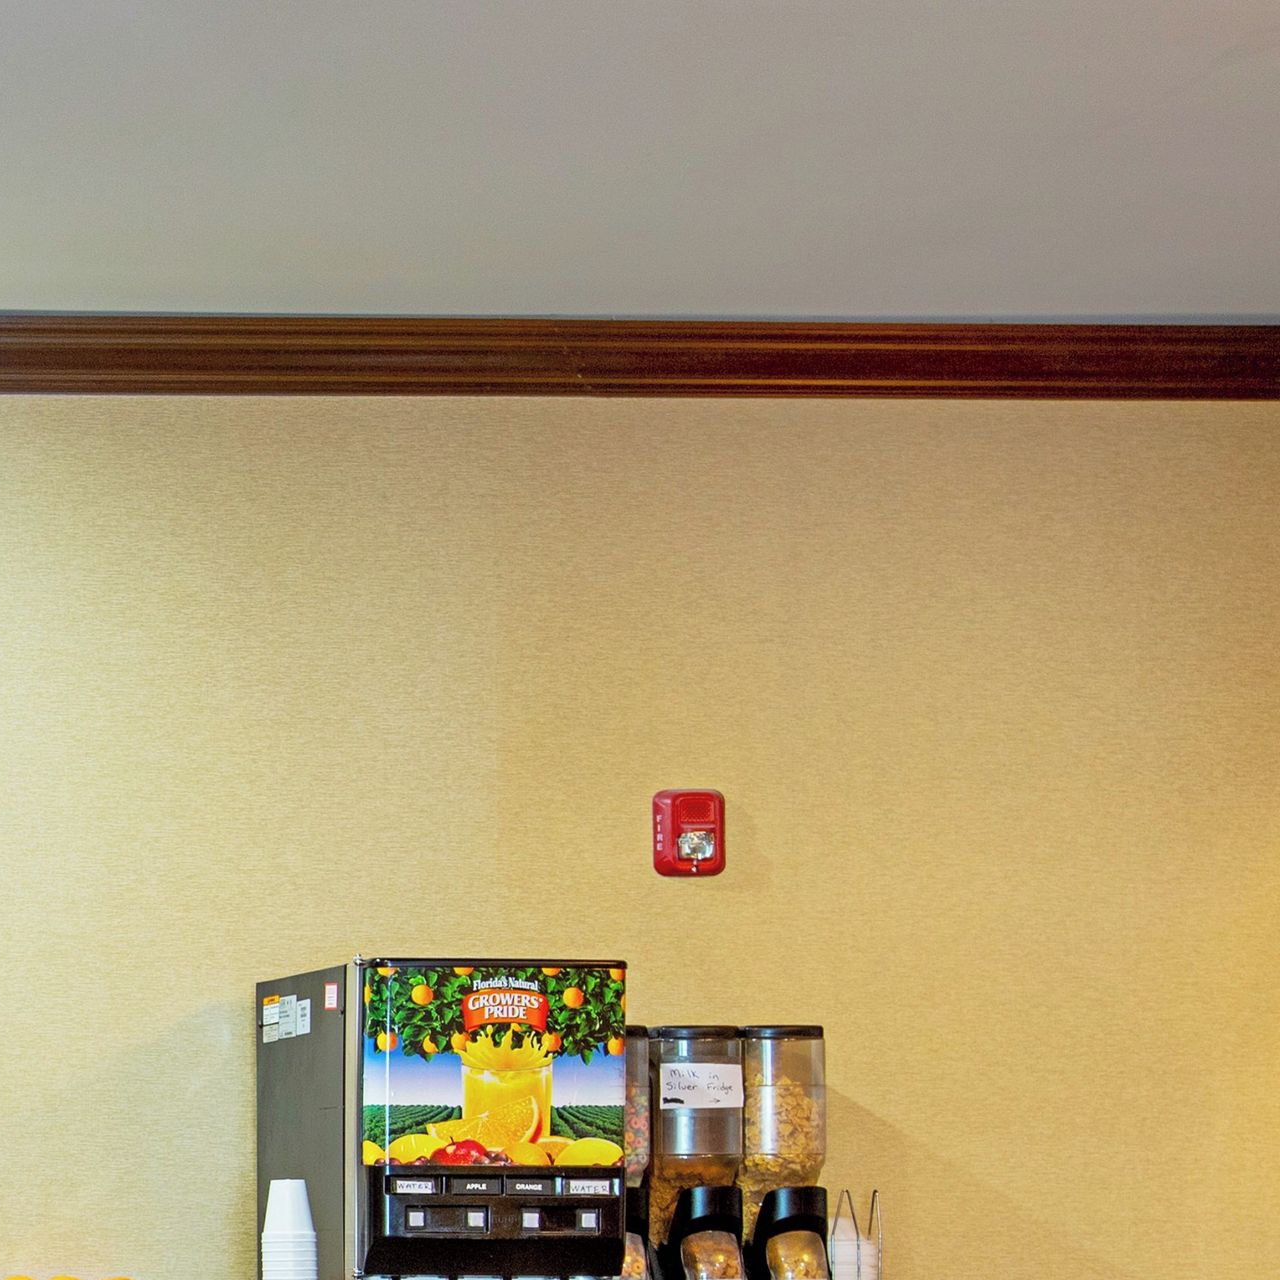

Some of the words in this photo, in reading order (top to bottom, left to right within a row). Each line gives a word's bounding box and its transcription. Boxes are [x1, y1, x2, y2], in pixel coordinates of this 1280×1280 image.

[473, 976, 507, 991] Florida's
[508, 976, 540, 992] Natural
[484, 1005, 527, 1019] PRIDE
[670, 1069, 699, 1079] Milk
[709, 1072, 719, 1080] in
[666, 1081, 698, 1091] Silver
[707, 1082, 734, 1095] Fridge
[397, 1182, 432, 1191] WATER
[515, 1183, 543, 1191] ORANGE
[571, 1185, 609, 1193] WATER
